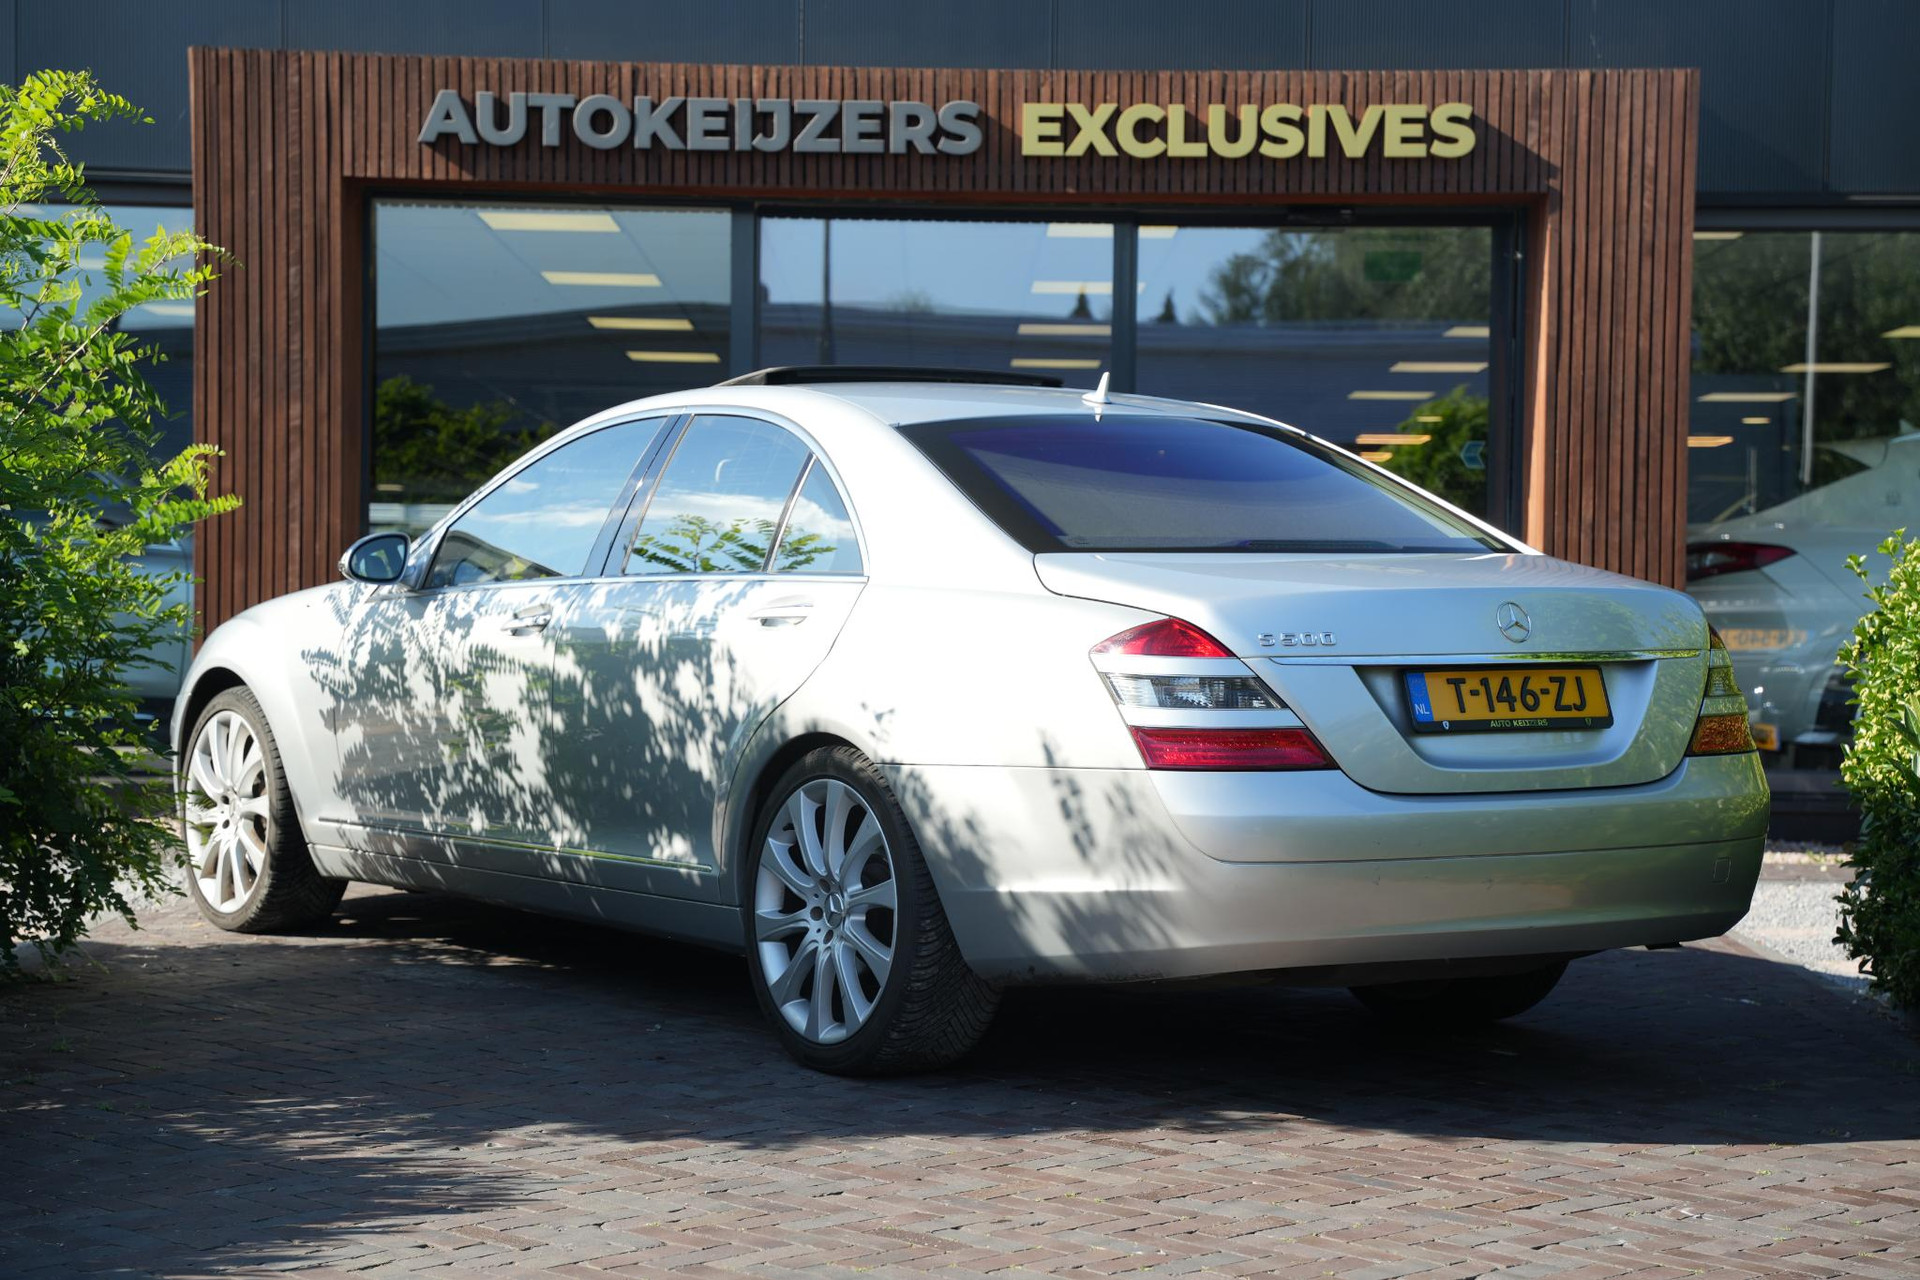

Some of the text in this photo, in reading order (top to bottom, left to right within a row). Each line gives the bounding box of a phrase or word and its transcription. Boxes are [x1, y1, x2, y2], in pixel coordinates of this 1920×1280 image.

[417, 88, 1477, 159] AUTOKEIJZERS EXCLUSIVES
[1446, 676, 1587, 713] T-146-ZJ
[1414, 703, 1430, 715] NL
[1490, 719, 1511, 728] AUTO
